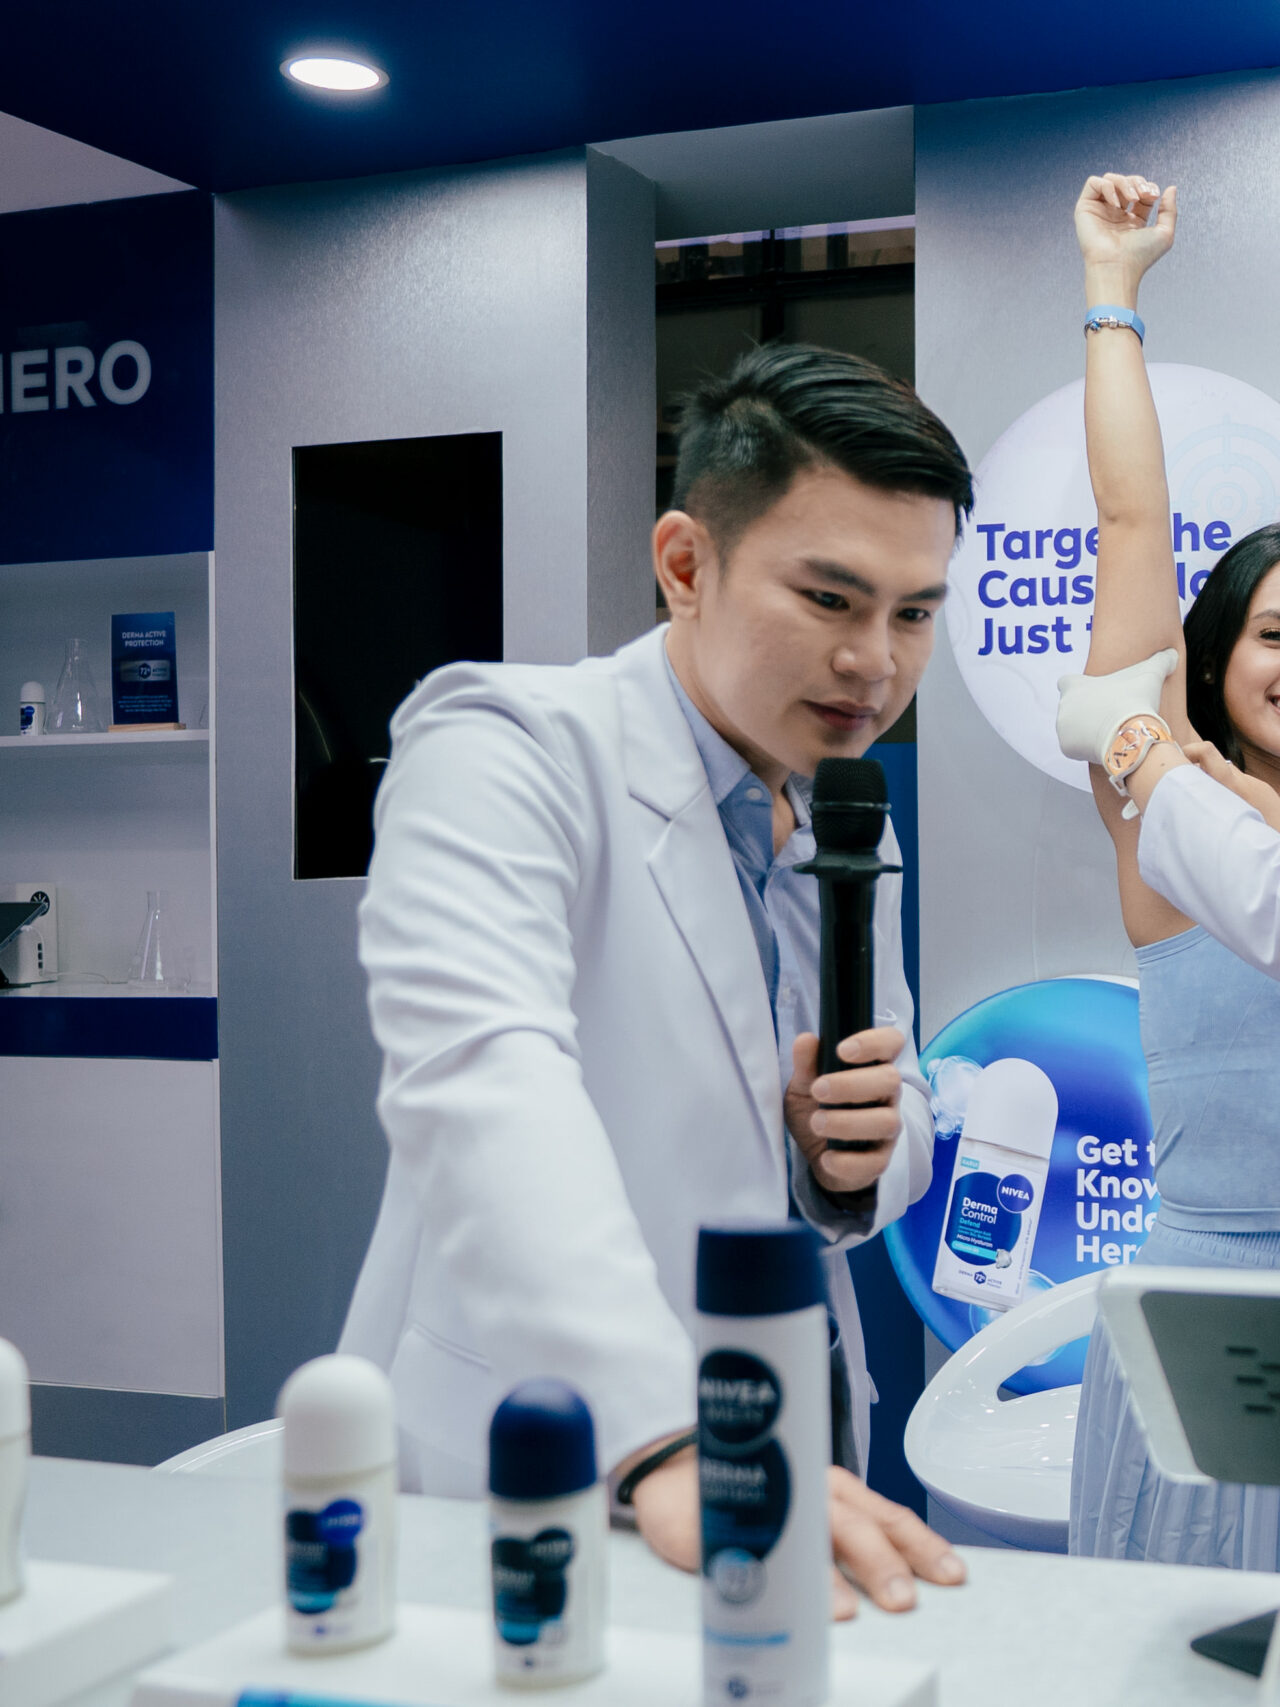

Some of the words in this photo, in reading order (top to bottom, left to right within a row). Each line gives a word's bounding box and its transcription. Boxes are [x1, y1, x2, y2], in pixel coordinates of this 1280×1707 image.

[0, 339, 152, 414] ERO
[121, 631, 144, 639] DERMA
[145, 630, 167, 638] ACTIVE
[124, 639, 164, 648] PROTECTION
[977, 615, 1074, 656] Just
[1076, 1135, 1139, 1167] Get
[1001, 1185, 1030, 1201] NIVEA
[961, 1206, 997, 1225] Control
[962, 1197, 998, 1214] Derma
[1076, 1234, 1142, 1265] Her
[699, 1376, 777, 1406] NIVEA
